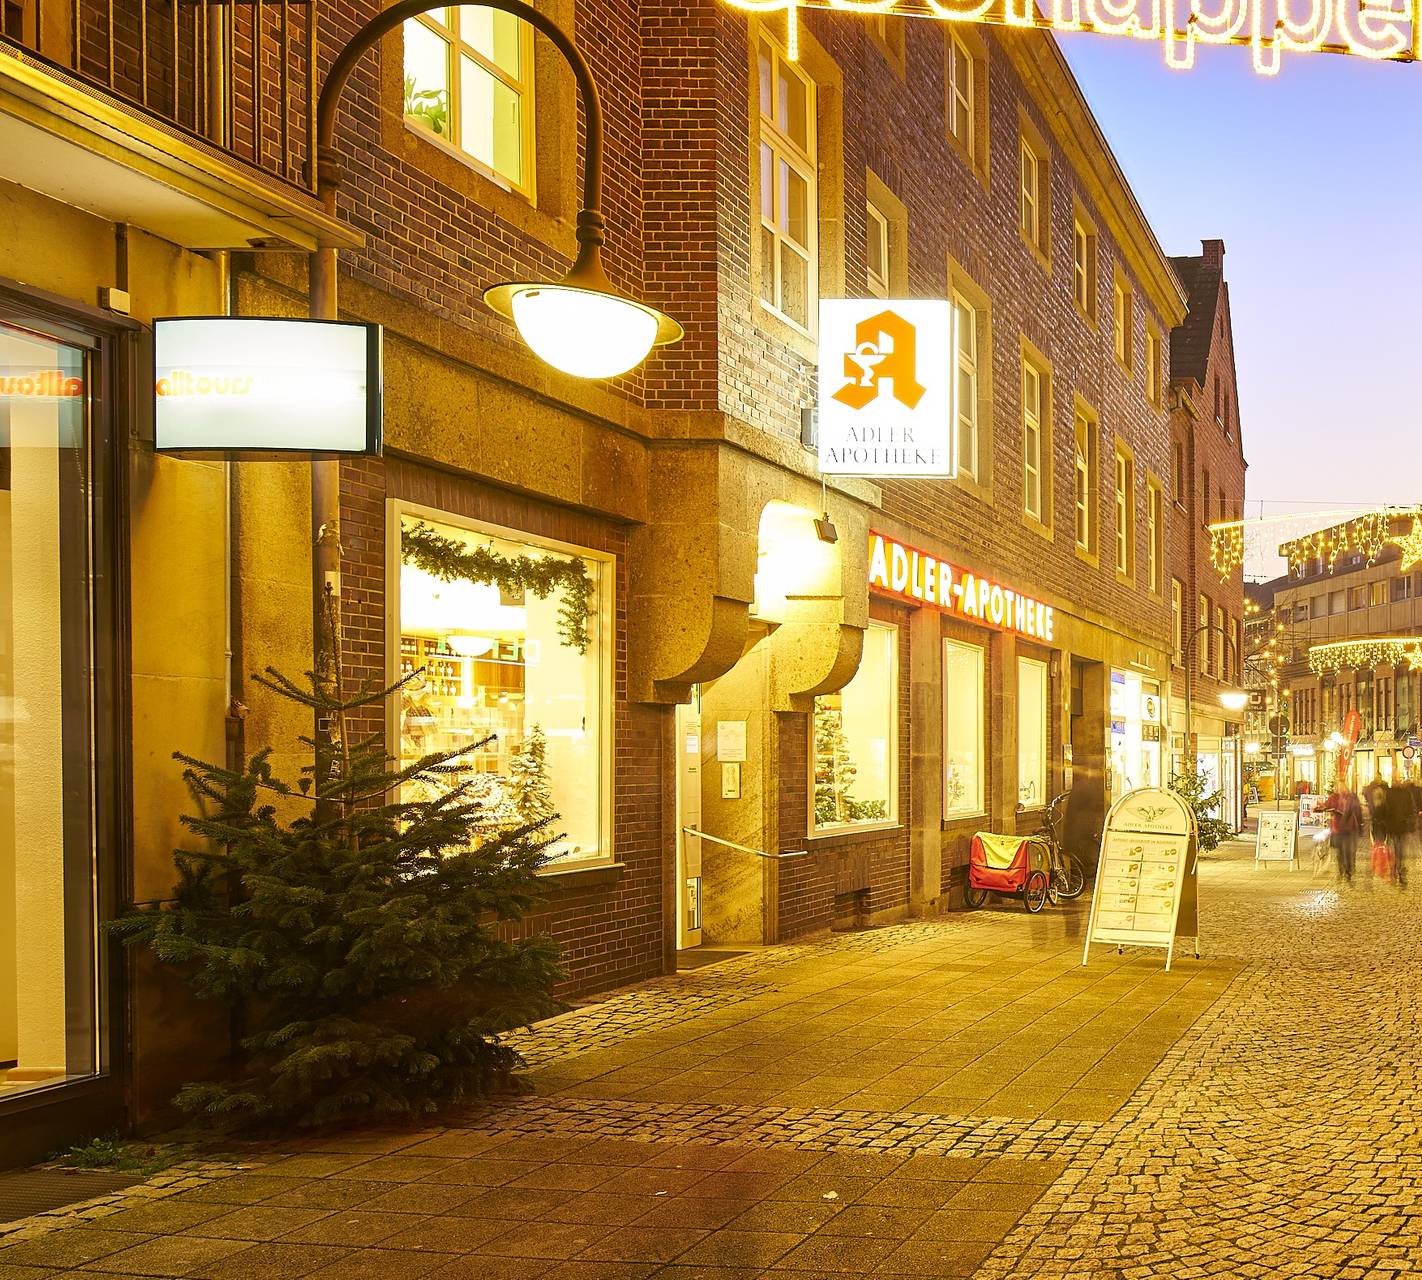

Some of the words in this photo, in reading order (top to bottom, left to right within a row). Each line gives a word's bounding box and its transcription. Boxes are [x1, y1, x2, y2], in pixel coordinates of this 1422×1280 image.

[156, 369, 256, 397] alltours
[846, 426, 915, 443] ADLER
[826, 447, 941, 465] APOTHEKE
[868, 535, 1054, 642] ADLER-APOTHEKE
